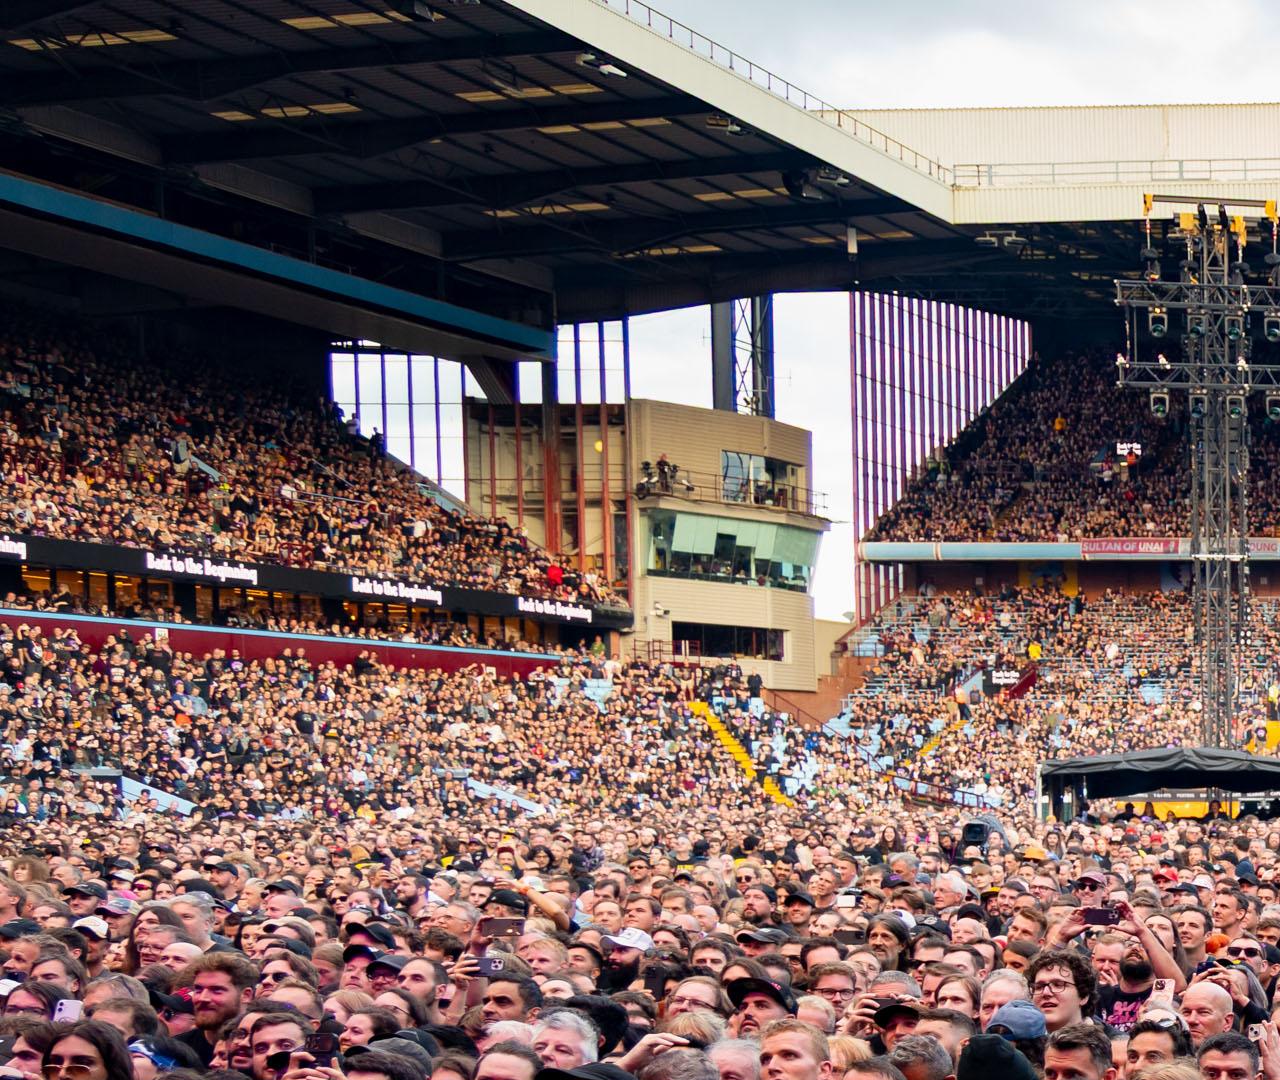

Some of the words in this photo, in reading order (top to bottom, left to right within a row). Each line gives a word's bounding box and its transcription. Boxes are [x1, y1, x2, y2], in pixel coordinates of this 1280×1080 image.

[1082, 542, 1122, 553] SULTAN
[1123, 542, 1137, 553] OF
[1138, 543, 1164, 553] UNAI
[203, 559, 258, 585] Beginning
